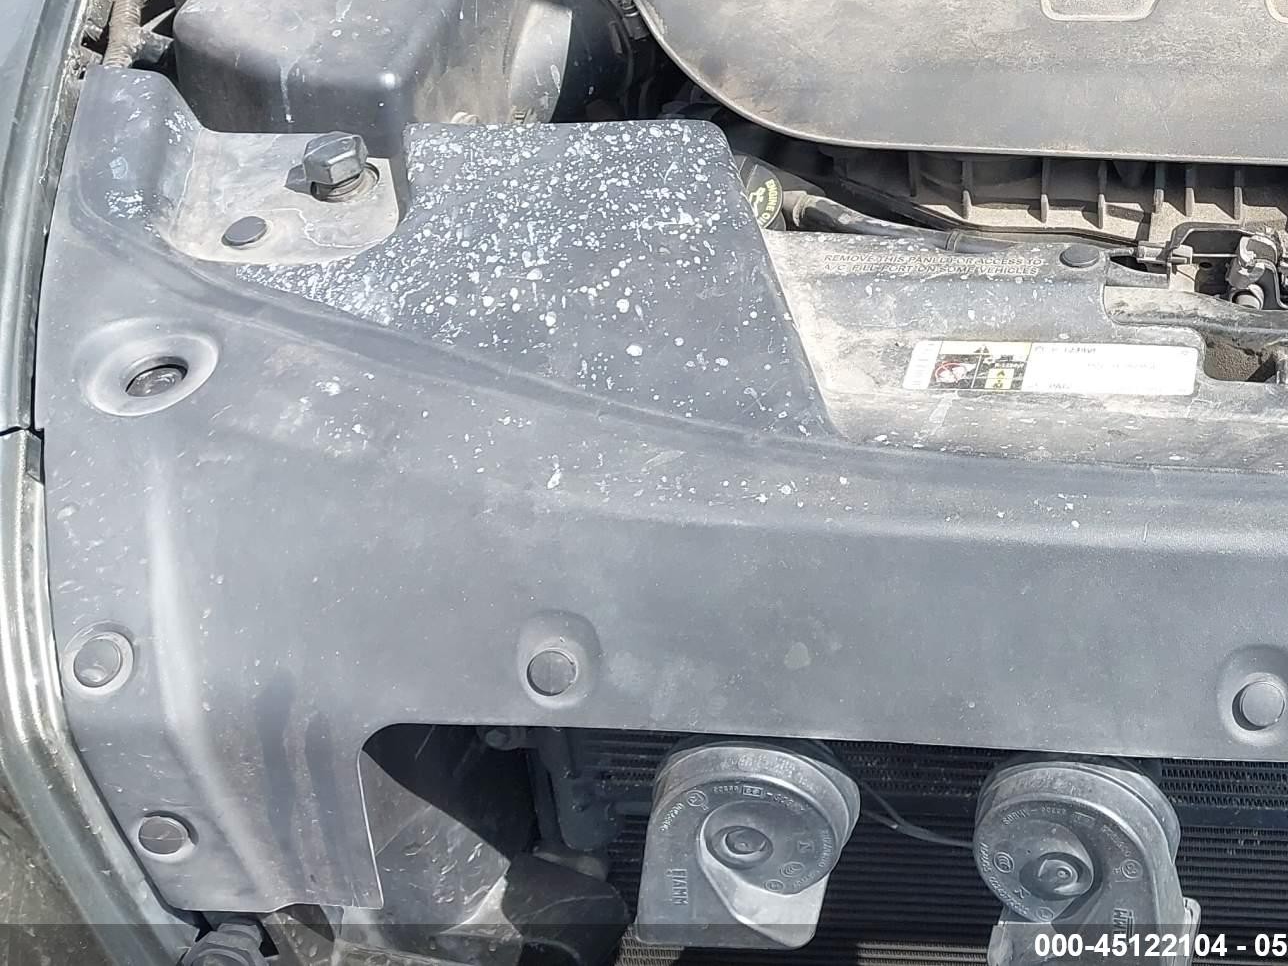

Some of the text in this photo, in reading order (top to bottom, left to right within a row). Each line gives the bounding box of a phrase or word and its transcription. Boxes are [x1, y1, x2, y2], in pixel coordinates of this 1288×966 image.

[765, 179, 778, 212] ENGINE
[824, 254, 875, 262] REMOVE
[877, 255, 905, 263] THIS
[976, 257, 1023, 265] ACCESS
[1027, 258, 1042, 266] TO
[978, 266, 1039, 274] VEHICLES
